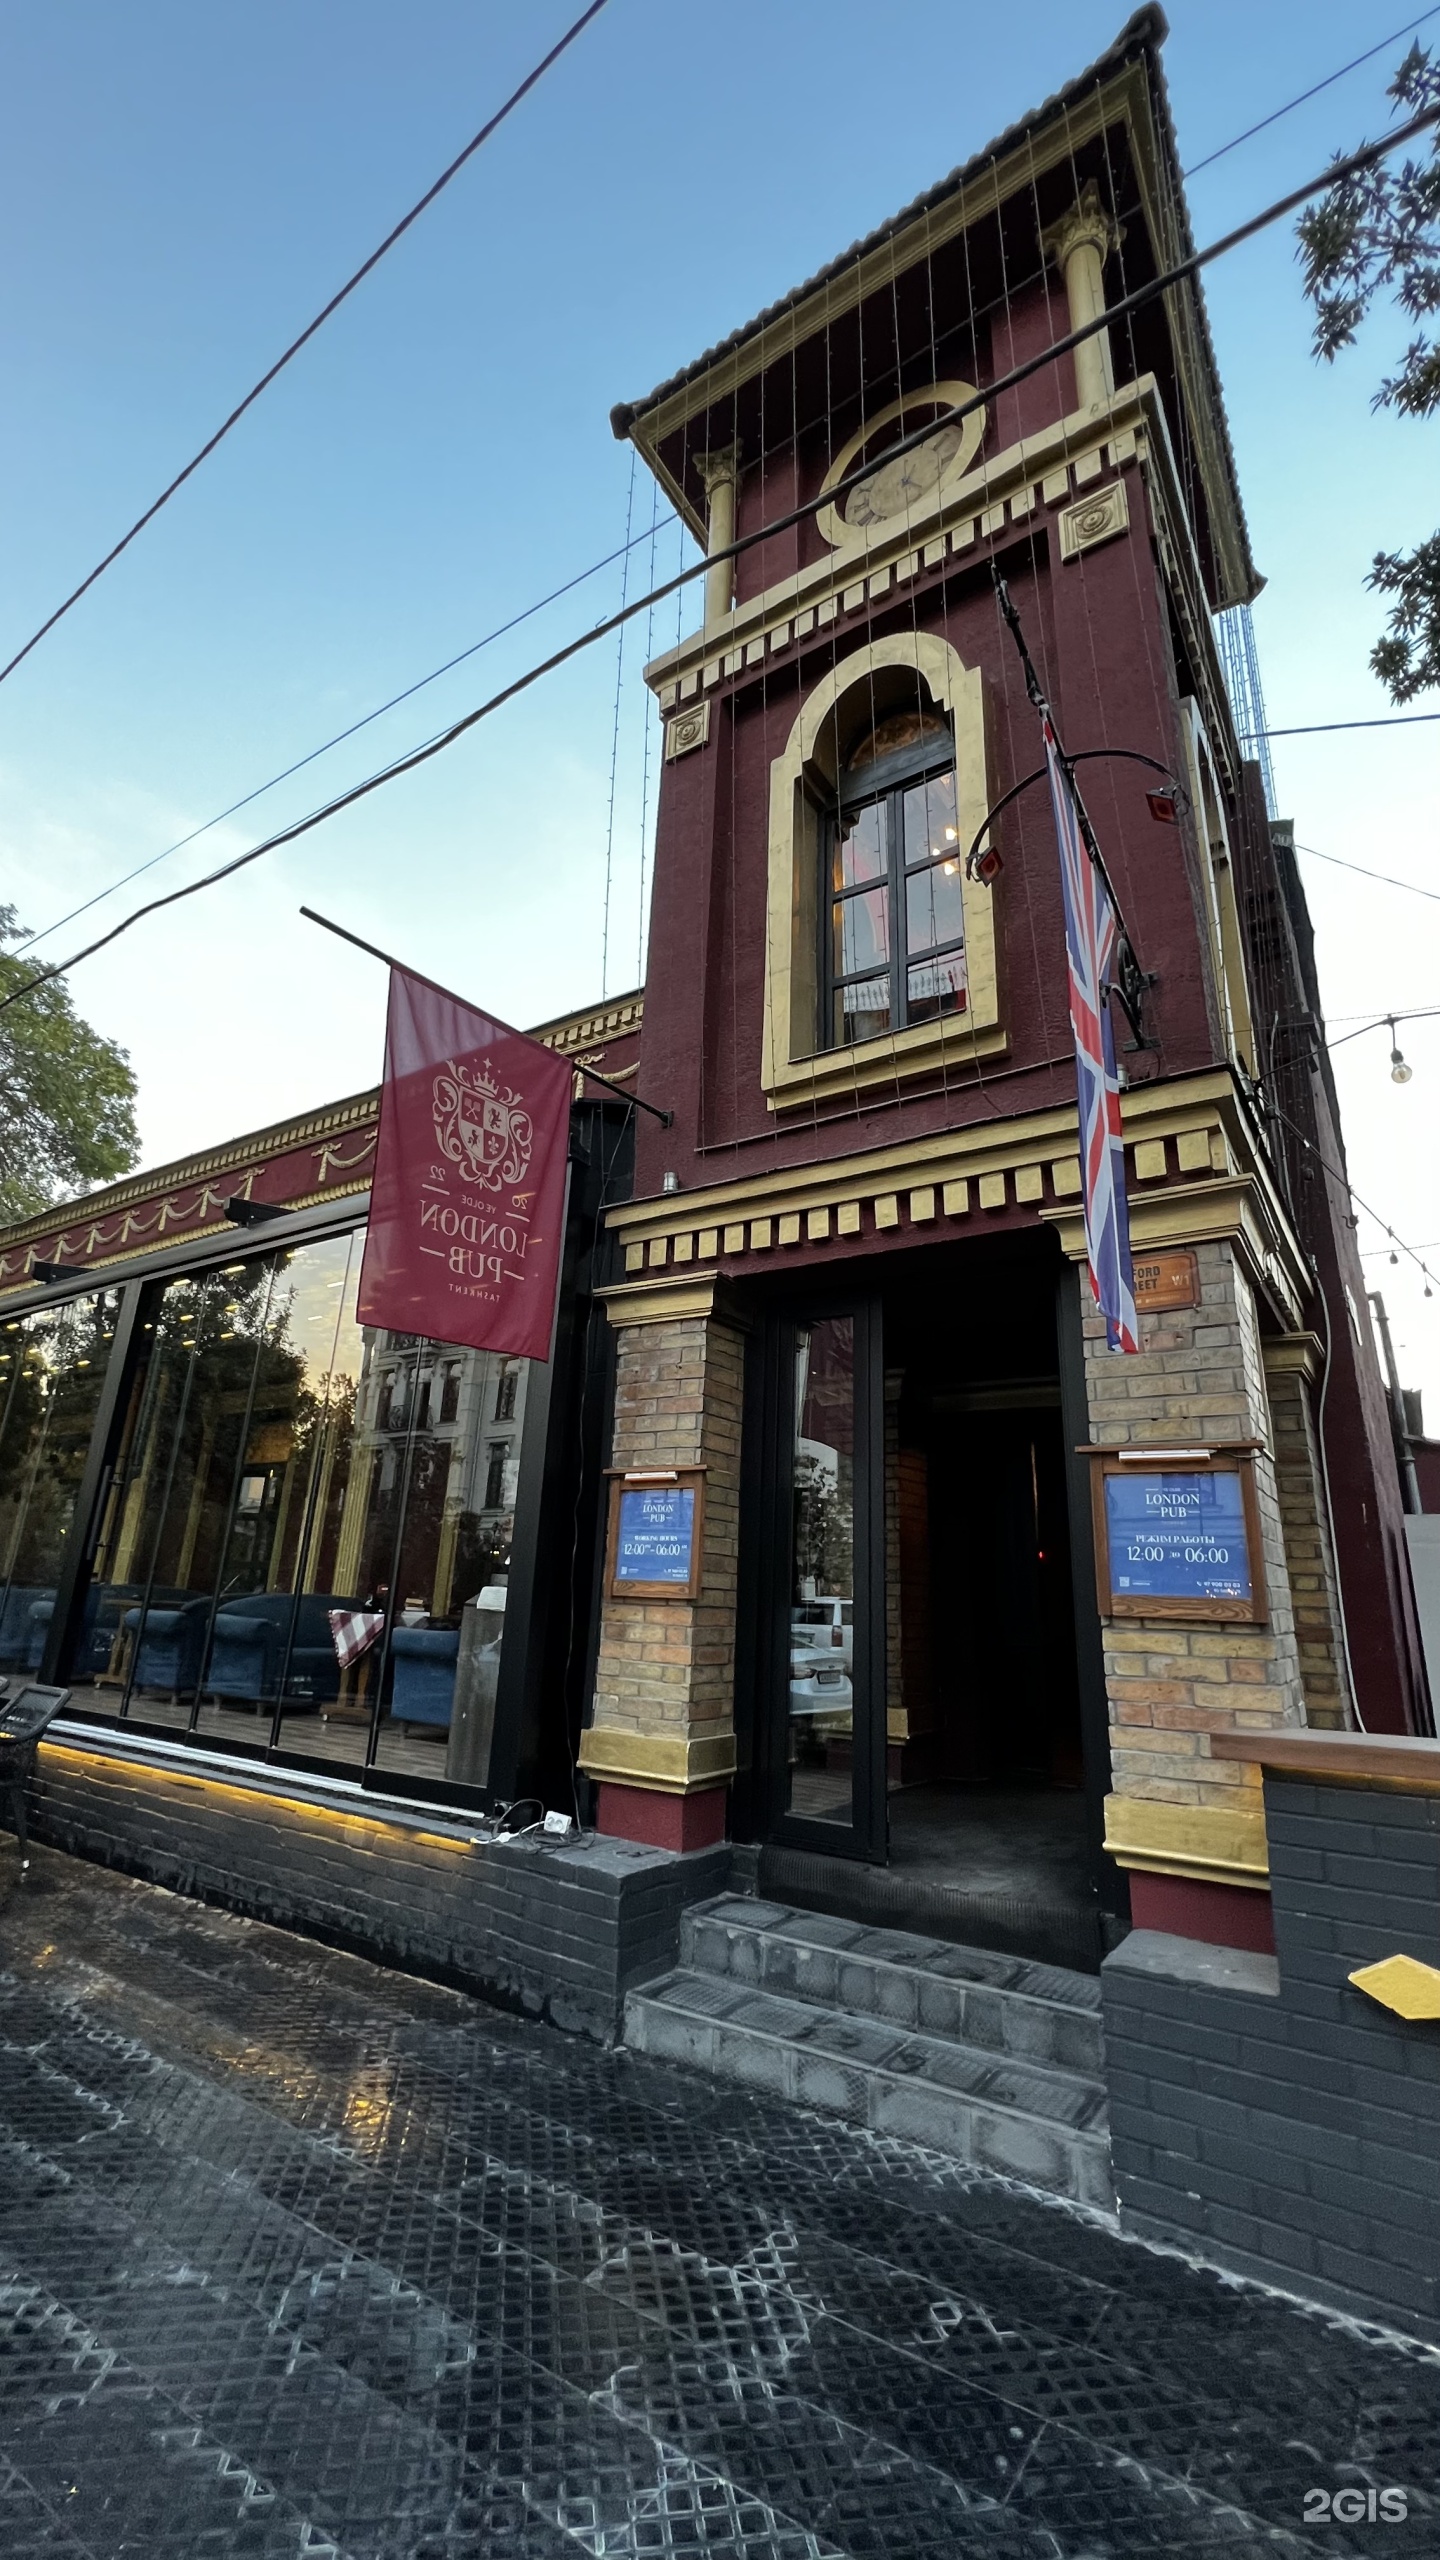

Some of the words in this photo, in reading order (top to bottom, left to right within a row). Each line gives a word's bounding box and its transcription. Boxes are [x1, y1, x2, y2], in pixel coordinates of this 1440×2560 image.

[1145, 1493, 1200, 1505] LONDON
[643, 1504, 674, 1513] LONDON
[1160, 1506, 1187, 1518] PUB
[650, 1513, 666, 1522] PUB
[1135, 1534, 1172, 1543] РЕЖИМ
[1173, 1535, 1215, 1544] РАБОТЫ
[656, 1543, 680, 1556] 06:00
[1127, 1545, 1164, 1562] 12:00
[1184, 1547, 1229, 1564] 06:00
